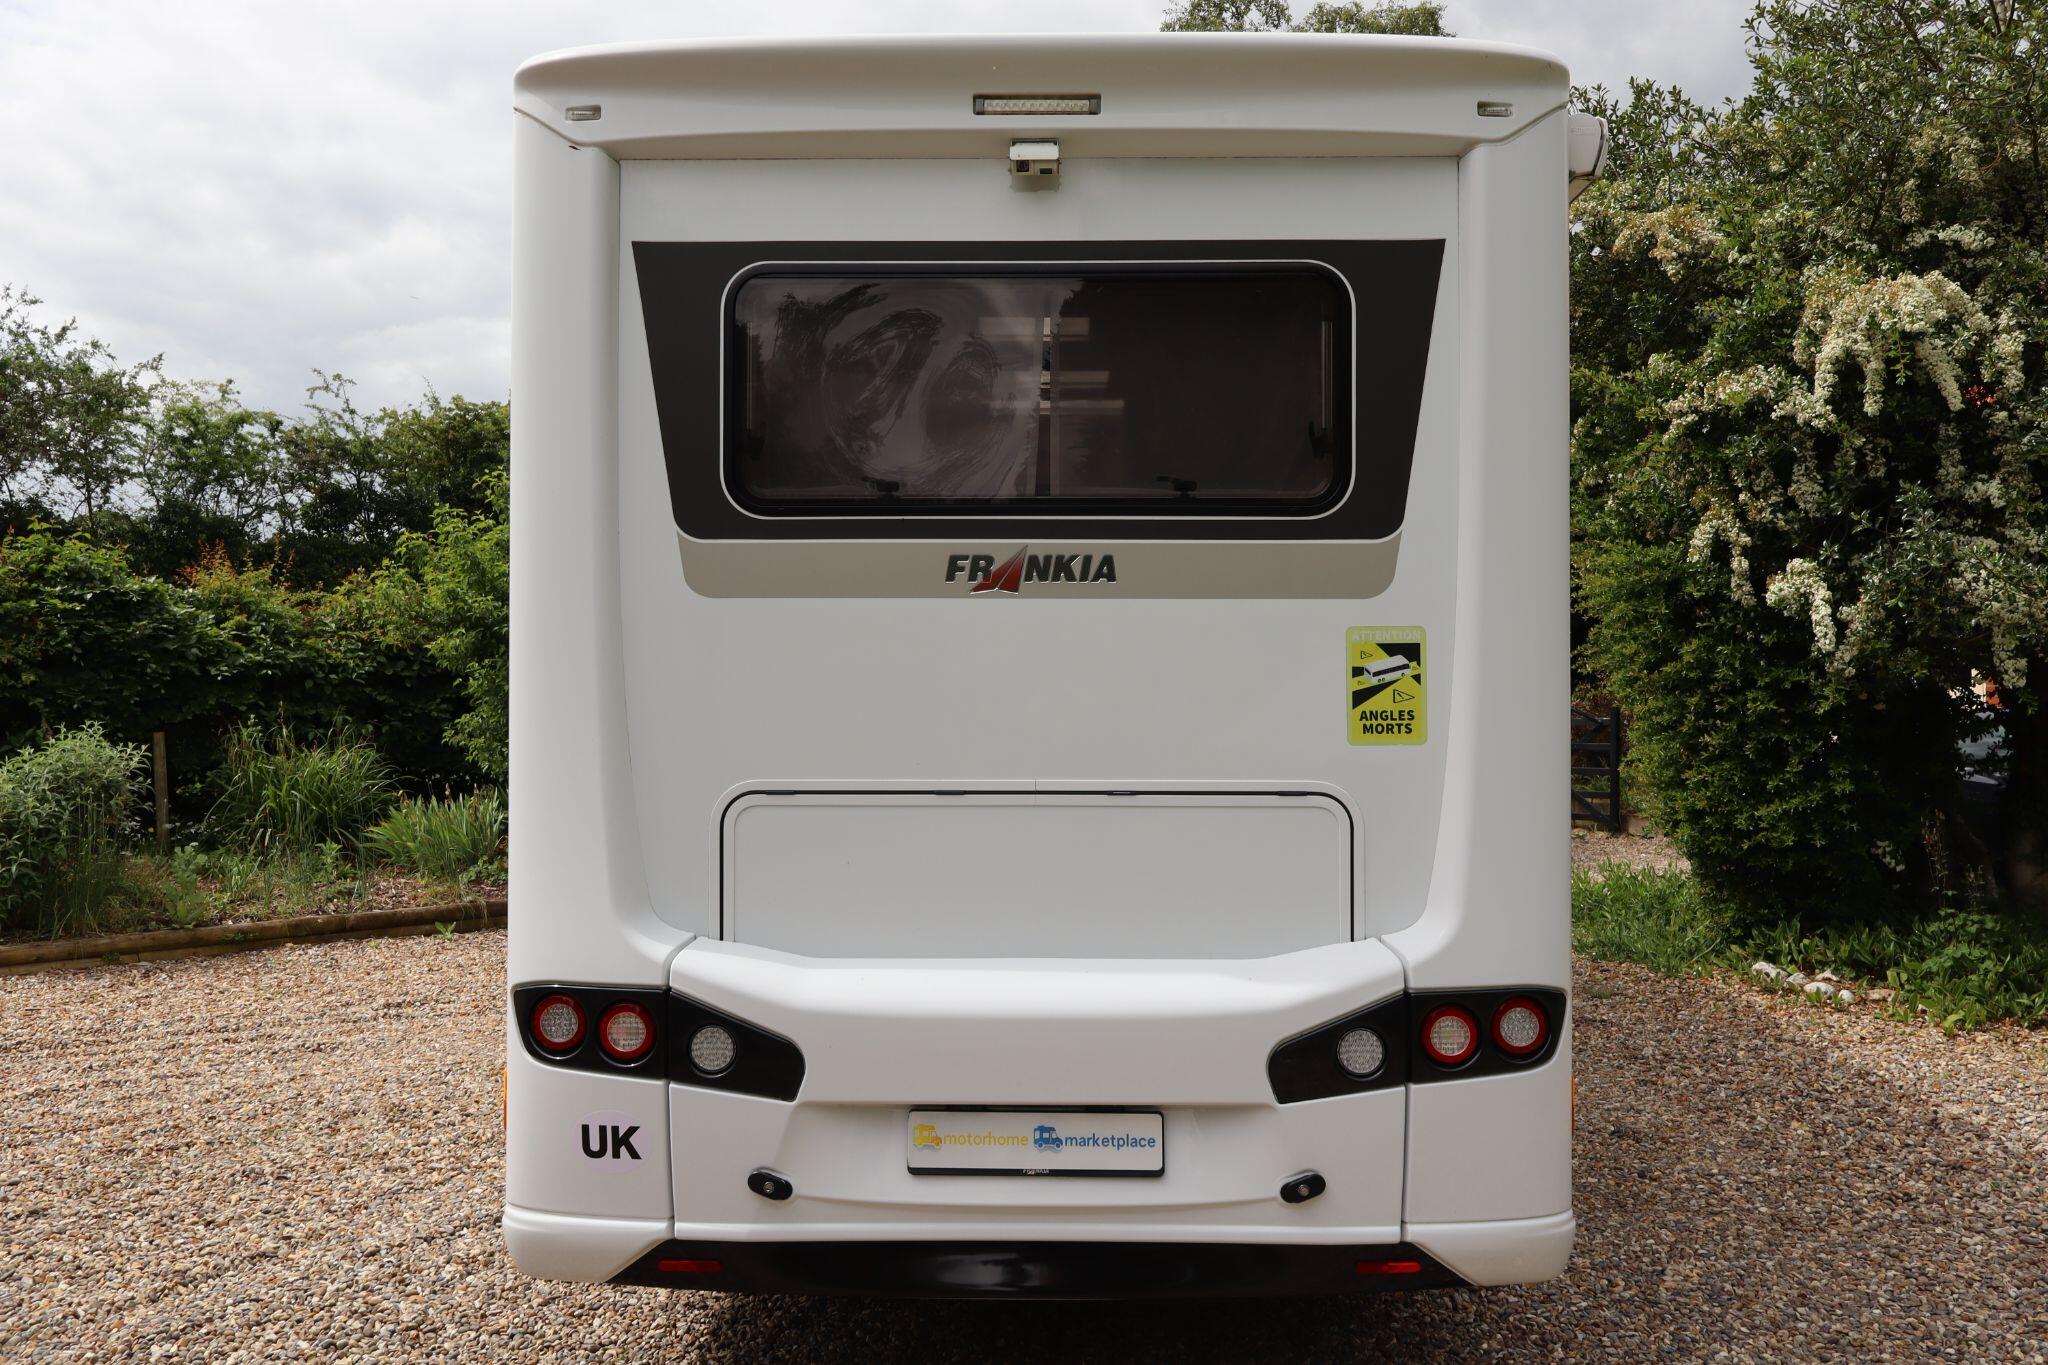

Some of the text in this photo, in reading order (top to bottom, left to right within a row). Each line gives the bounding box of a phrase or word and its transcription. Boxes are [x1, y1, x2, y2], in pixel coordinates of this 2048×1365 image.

[945, 544, 1117, 594] FRANKIA
[1352, 630, 1421, 641] ATTENTION
[1360, 710, 1415, 721] ANGLES
[1362, 723, 1413, 734] MORTS
[581, 1124, 642, 1160] UK
[943, 1132, 1156, 1151] motorhome marketplace
